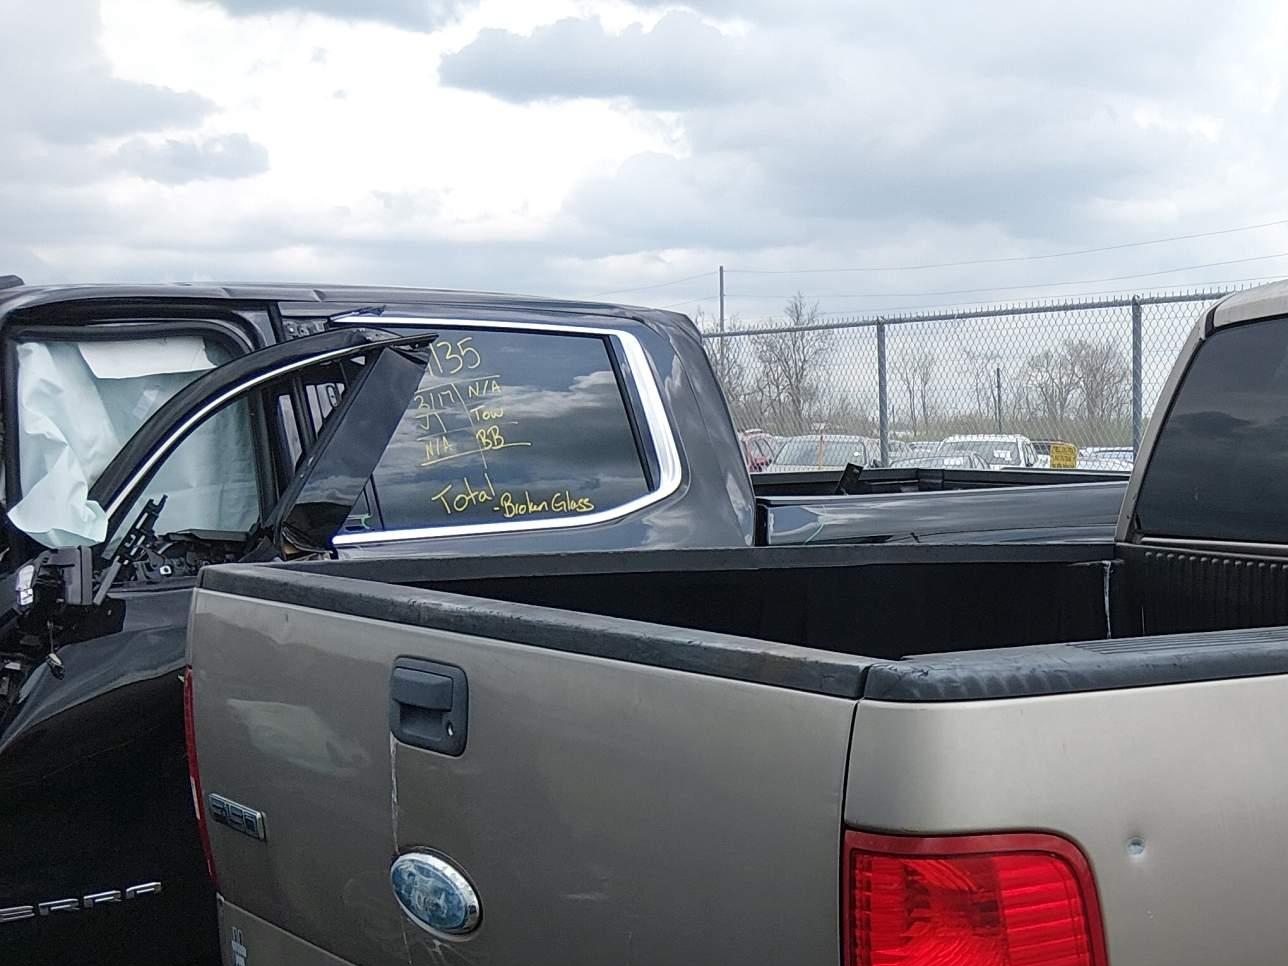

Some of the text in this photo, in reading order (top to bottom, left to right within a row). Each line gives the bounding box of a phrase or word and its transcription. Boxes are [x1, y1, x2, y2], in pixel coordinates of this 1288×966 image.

[468, 380, 501, 398] N/A
[470, 405, 504, 421] Tow
[431, 473, 496, 514] Total
